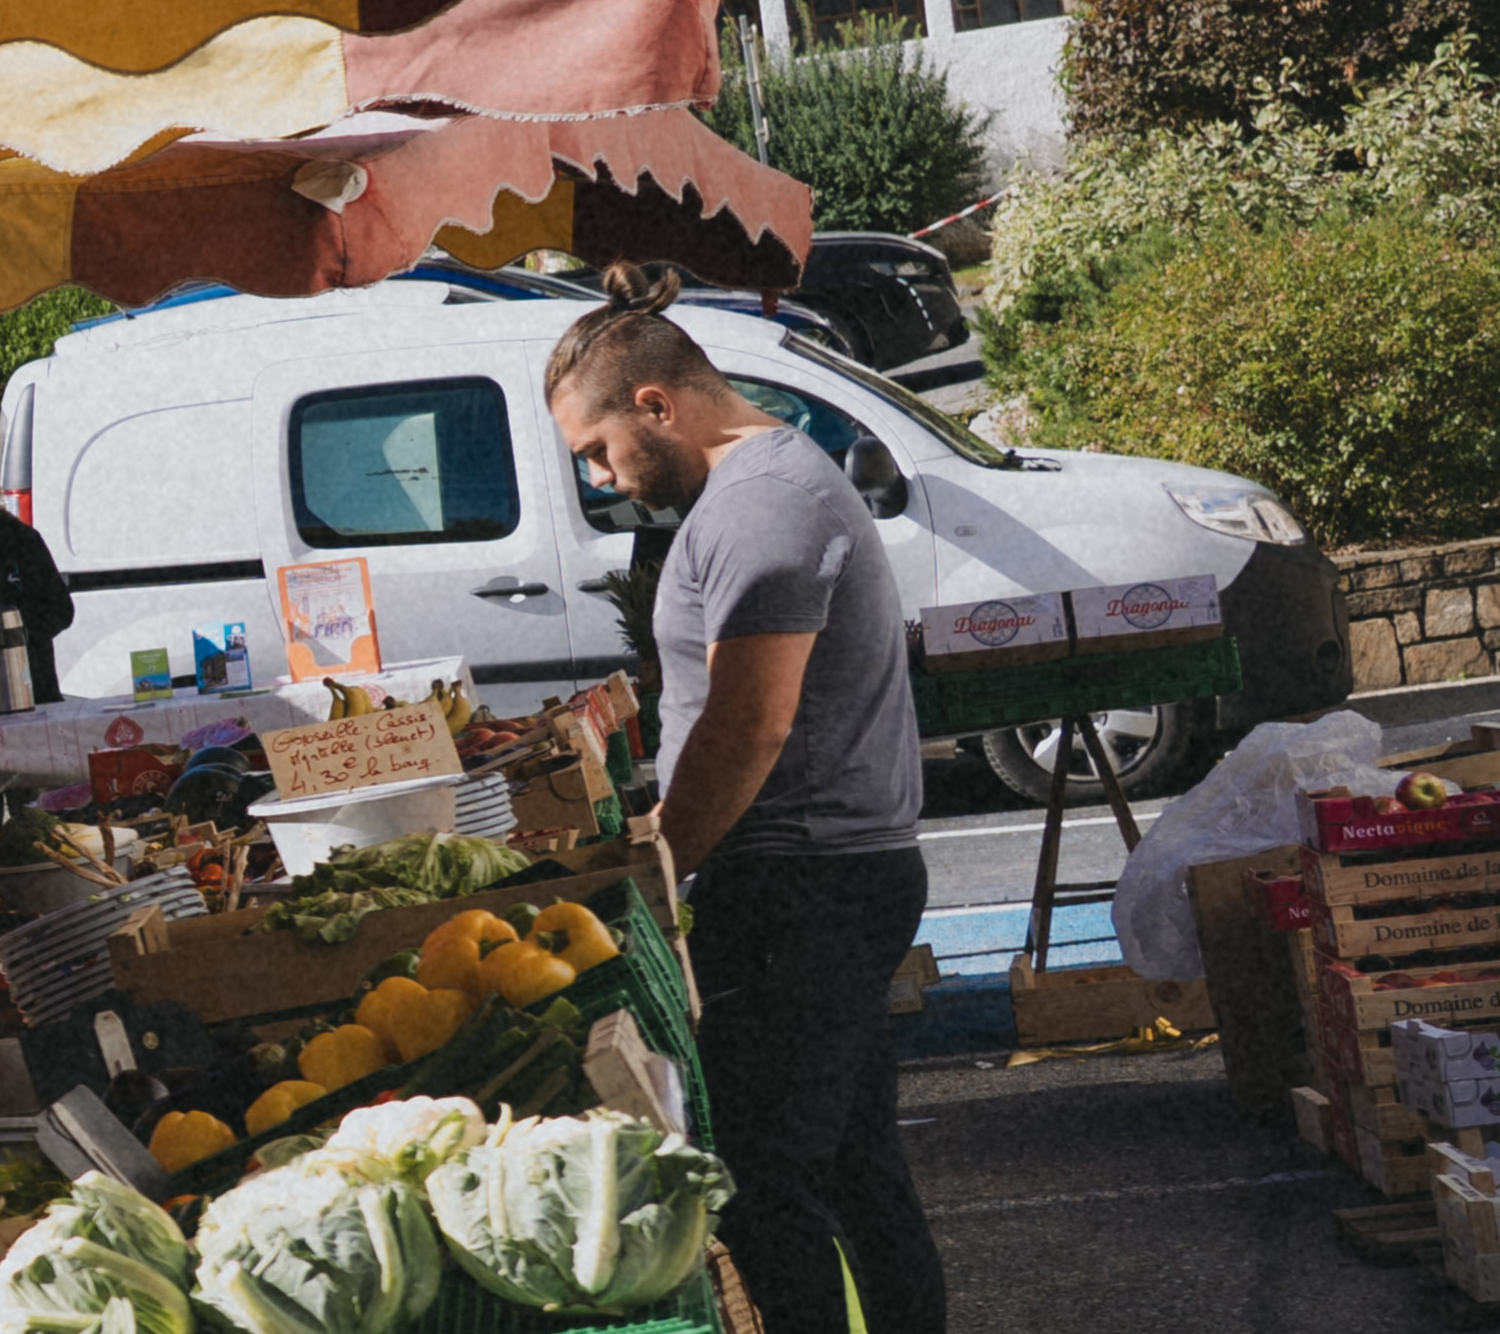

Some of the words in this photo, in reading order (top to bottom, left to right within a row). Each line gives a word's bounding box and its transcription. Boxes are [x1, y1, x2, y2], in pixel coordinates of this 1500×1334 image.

[1342, 818, 1446, 840] Nectavigne
[1364, 866, 1455, 889] Domaine
[1456, 861, 1480, 880] de
[1375, 918, 1462, 942] Domaine
[1467, 915, 1491, 933] de
[1393, 994, 1483, 1017] Domaine
